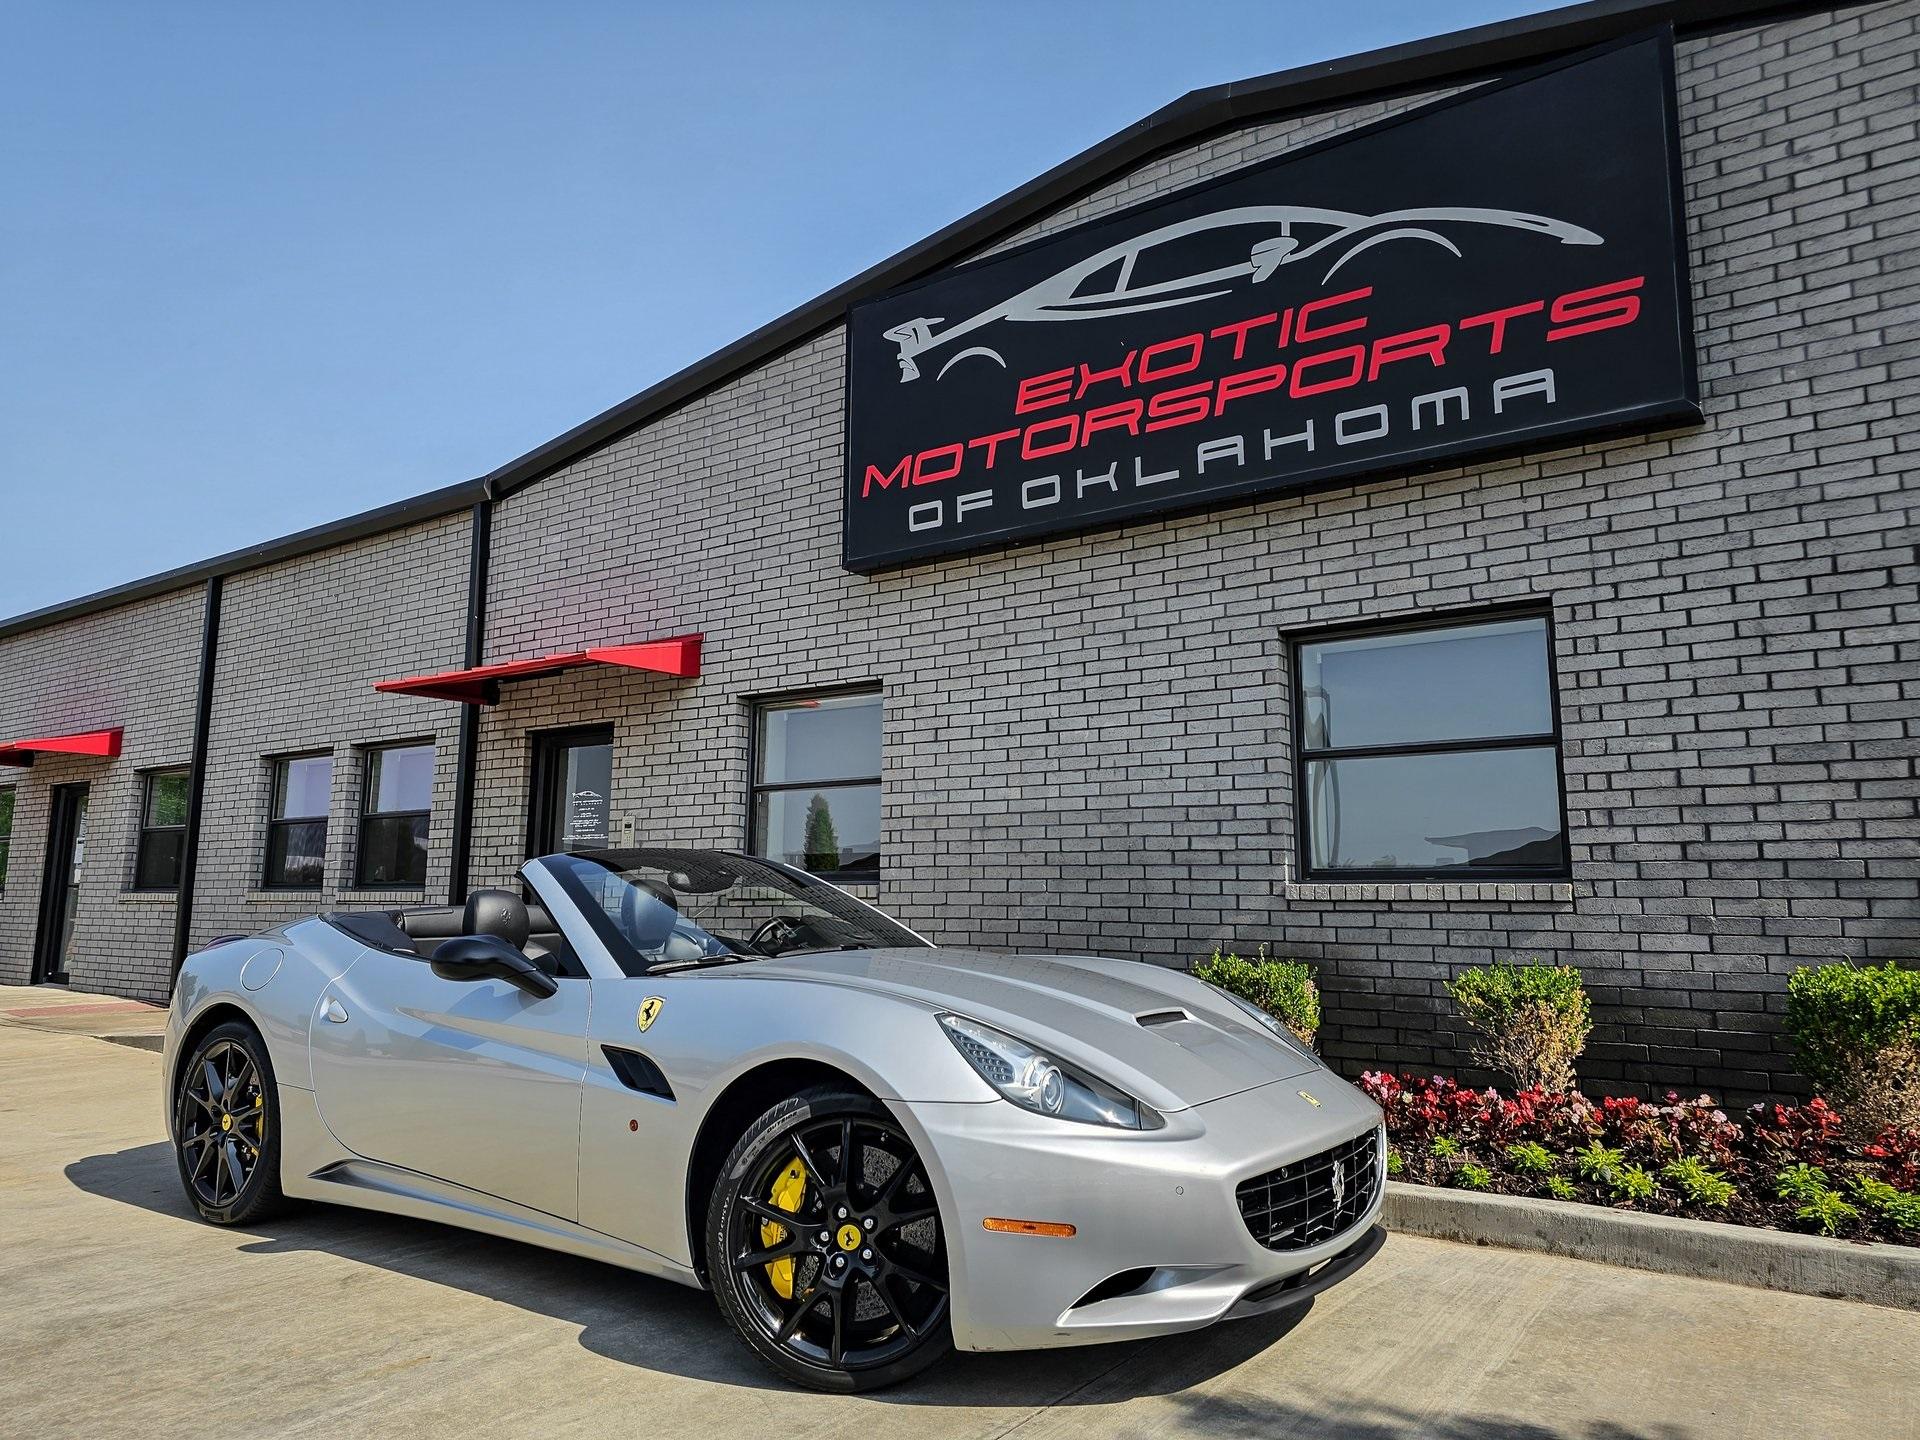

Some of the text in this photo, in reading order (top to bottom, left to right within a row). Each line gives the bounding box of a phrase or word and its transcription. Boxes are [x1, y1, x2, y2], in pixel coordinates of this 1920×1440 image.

[863, 277, 1645, 497] MOTORSPORTS
[1016, 287, 1373, 415] EXOTIC
[909, 369, 1556, 533] OF OKLAHOMA
